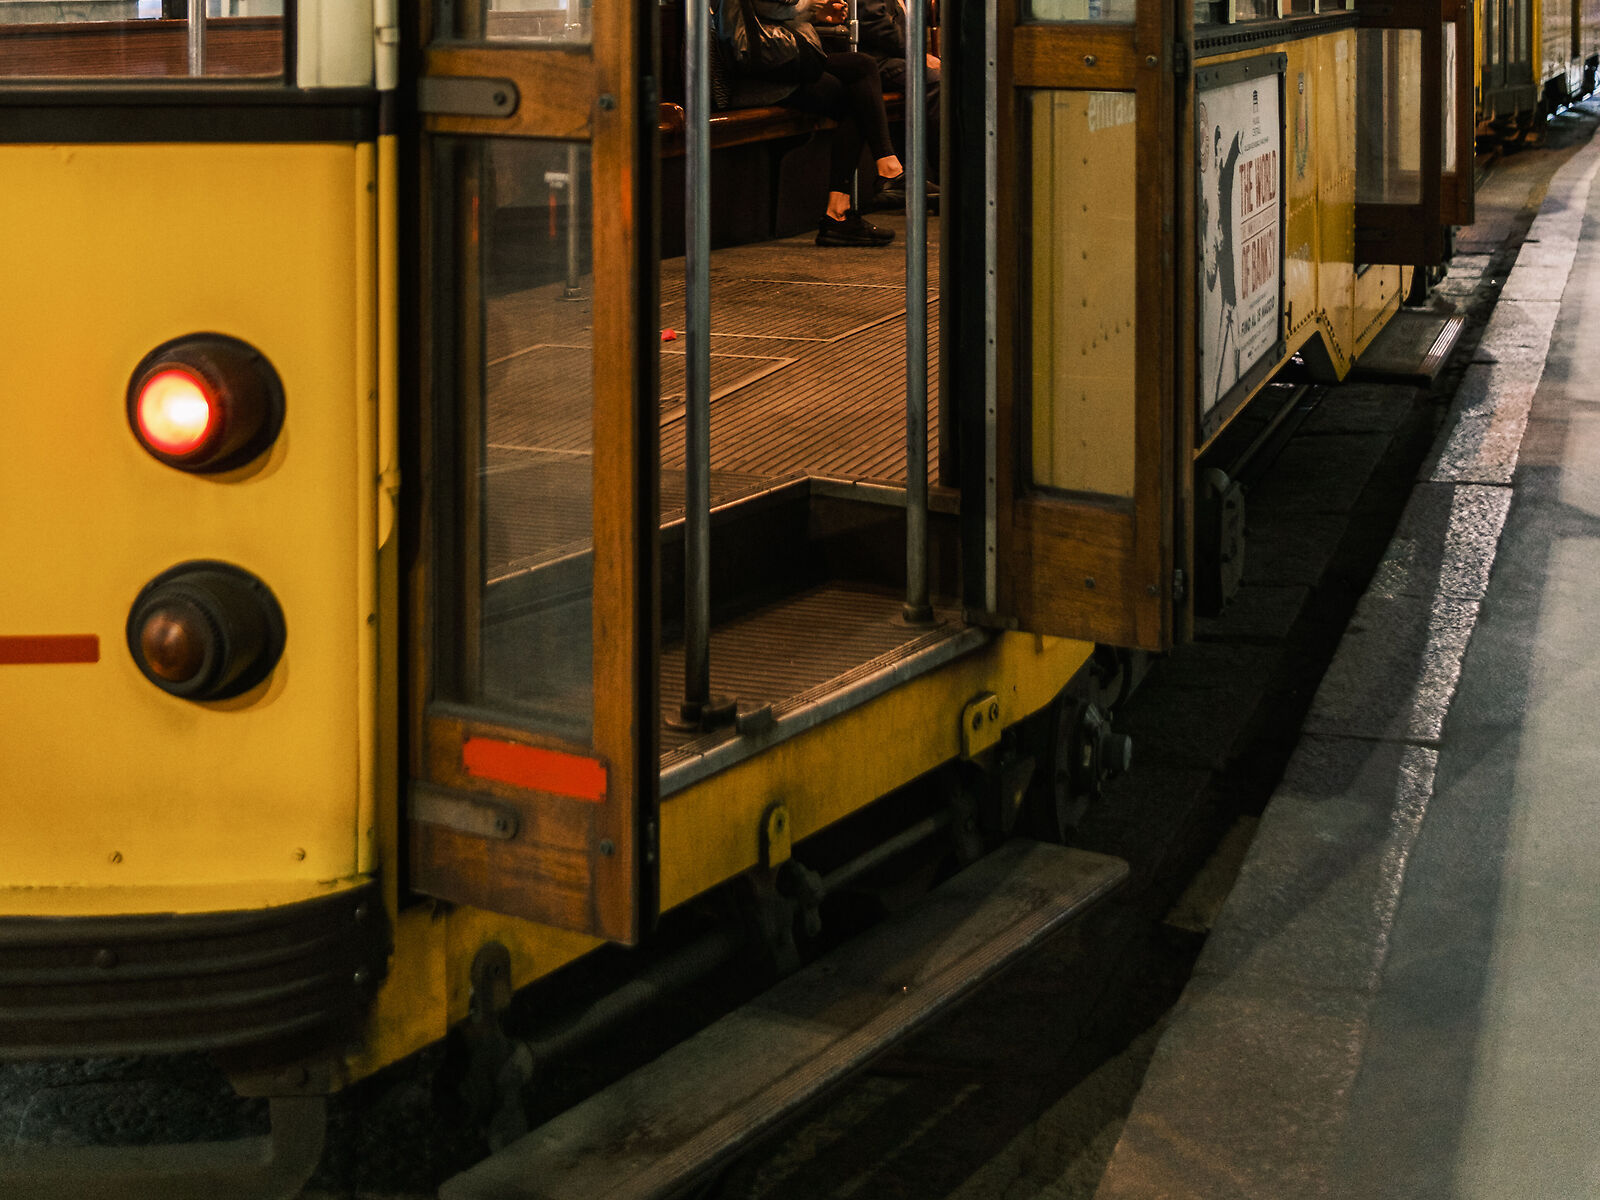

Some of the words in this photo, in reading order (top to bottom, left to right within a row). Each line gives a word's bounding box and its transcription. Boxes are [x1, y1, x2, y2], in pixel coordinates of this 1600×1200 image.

[1239, 160, 1253, 217] THE
[1255, 150, 1276, 209] WORLD
[1241, 243, 1250, 300] OF
